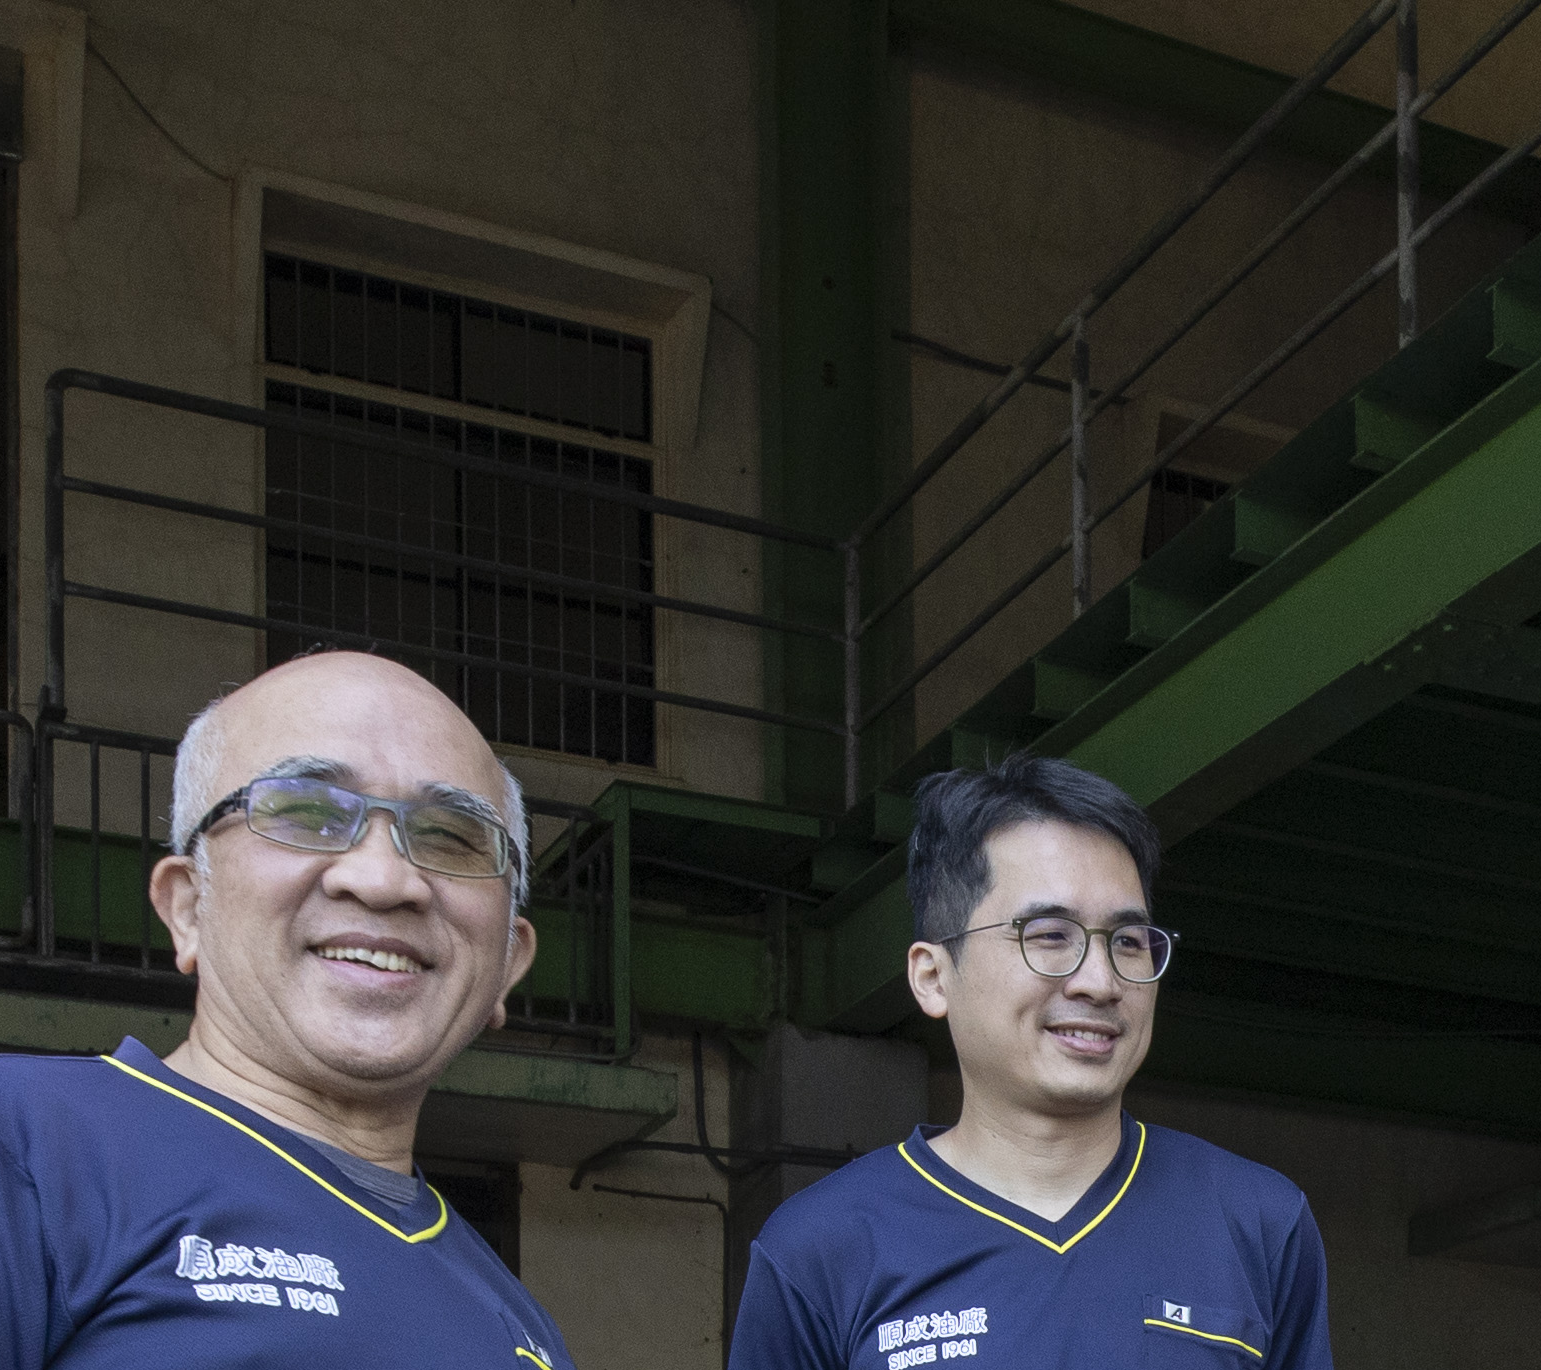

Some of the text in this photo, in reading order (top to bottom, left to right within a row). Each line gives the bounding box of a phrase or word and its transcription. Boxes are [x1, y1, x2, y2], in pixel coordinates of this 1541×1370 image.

[175, 1235, 345, 1291] 順成油廠
[193, 1283, 340, 1317] SINCE 1961
[878, 1307, 988, 1352] 順成油廠
[942, 1339, 977, 1360] 1961
